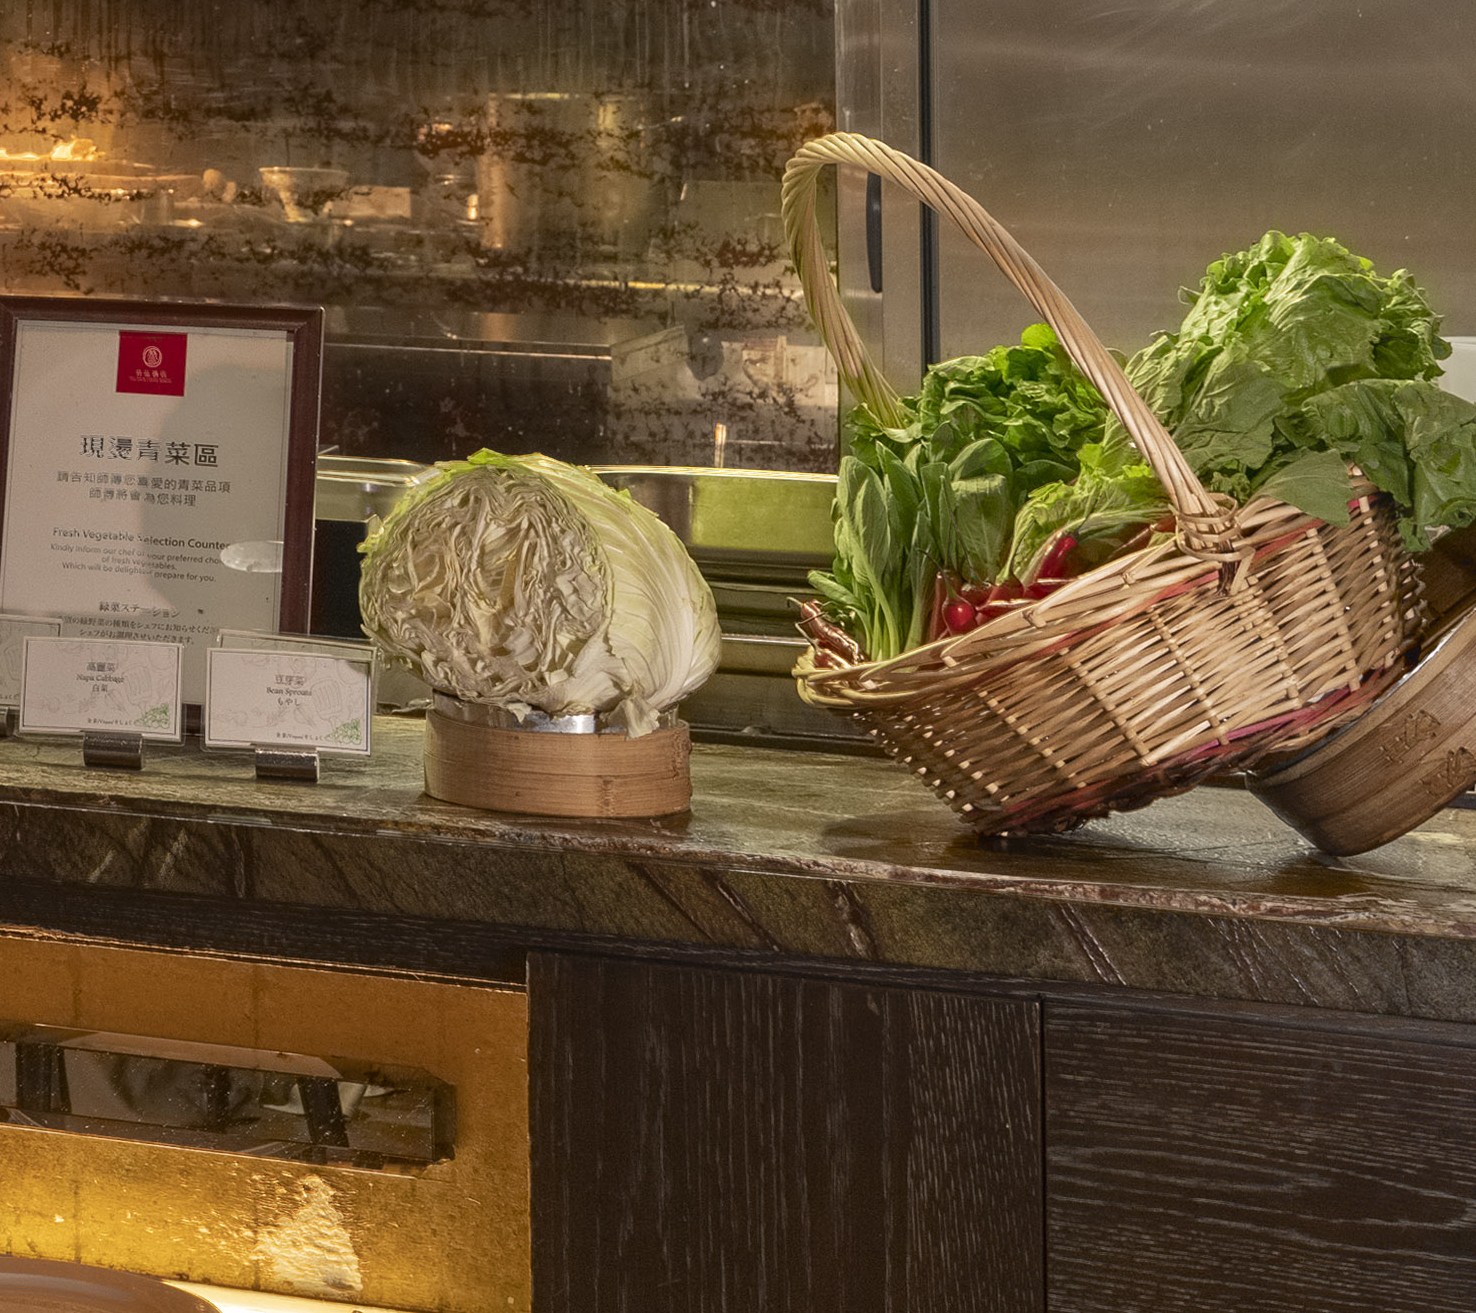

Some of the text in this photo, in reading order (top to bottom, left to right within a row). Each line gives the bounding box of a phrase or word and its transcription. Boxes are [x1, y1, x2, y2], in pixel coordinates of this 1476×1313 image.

[52, 526, 80, 538] Fresh
[82, 528, 135, 542] Vegetable
[50, 544, 74, 553] Kindly
[75, 544, 101, 554] inform
[102, 547, 117, 555] our
[117, 547, 135, 557] chef
[166, 552, 203, 564] preferred
[111, 556, 131, 565] fresh
[62, 561, 87, 571] Which
[87, 563, 101, 572] will
[102, 564, 114, 573] be
[154, 570, 185, 581] prepare
[186, 572, 198, 581] for
